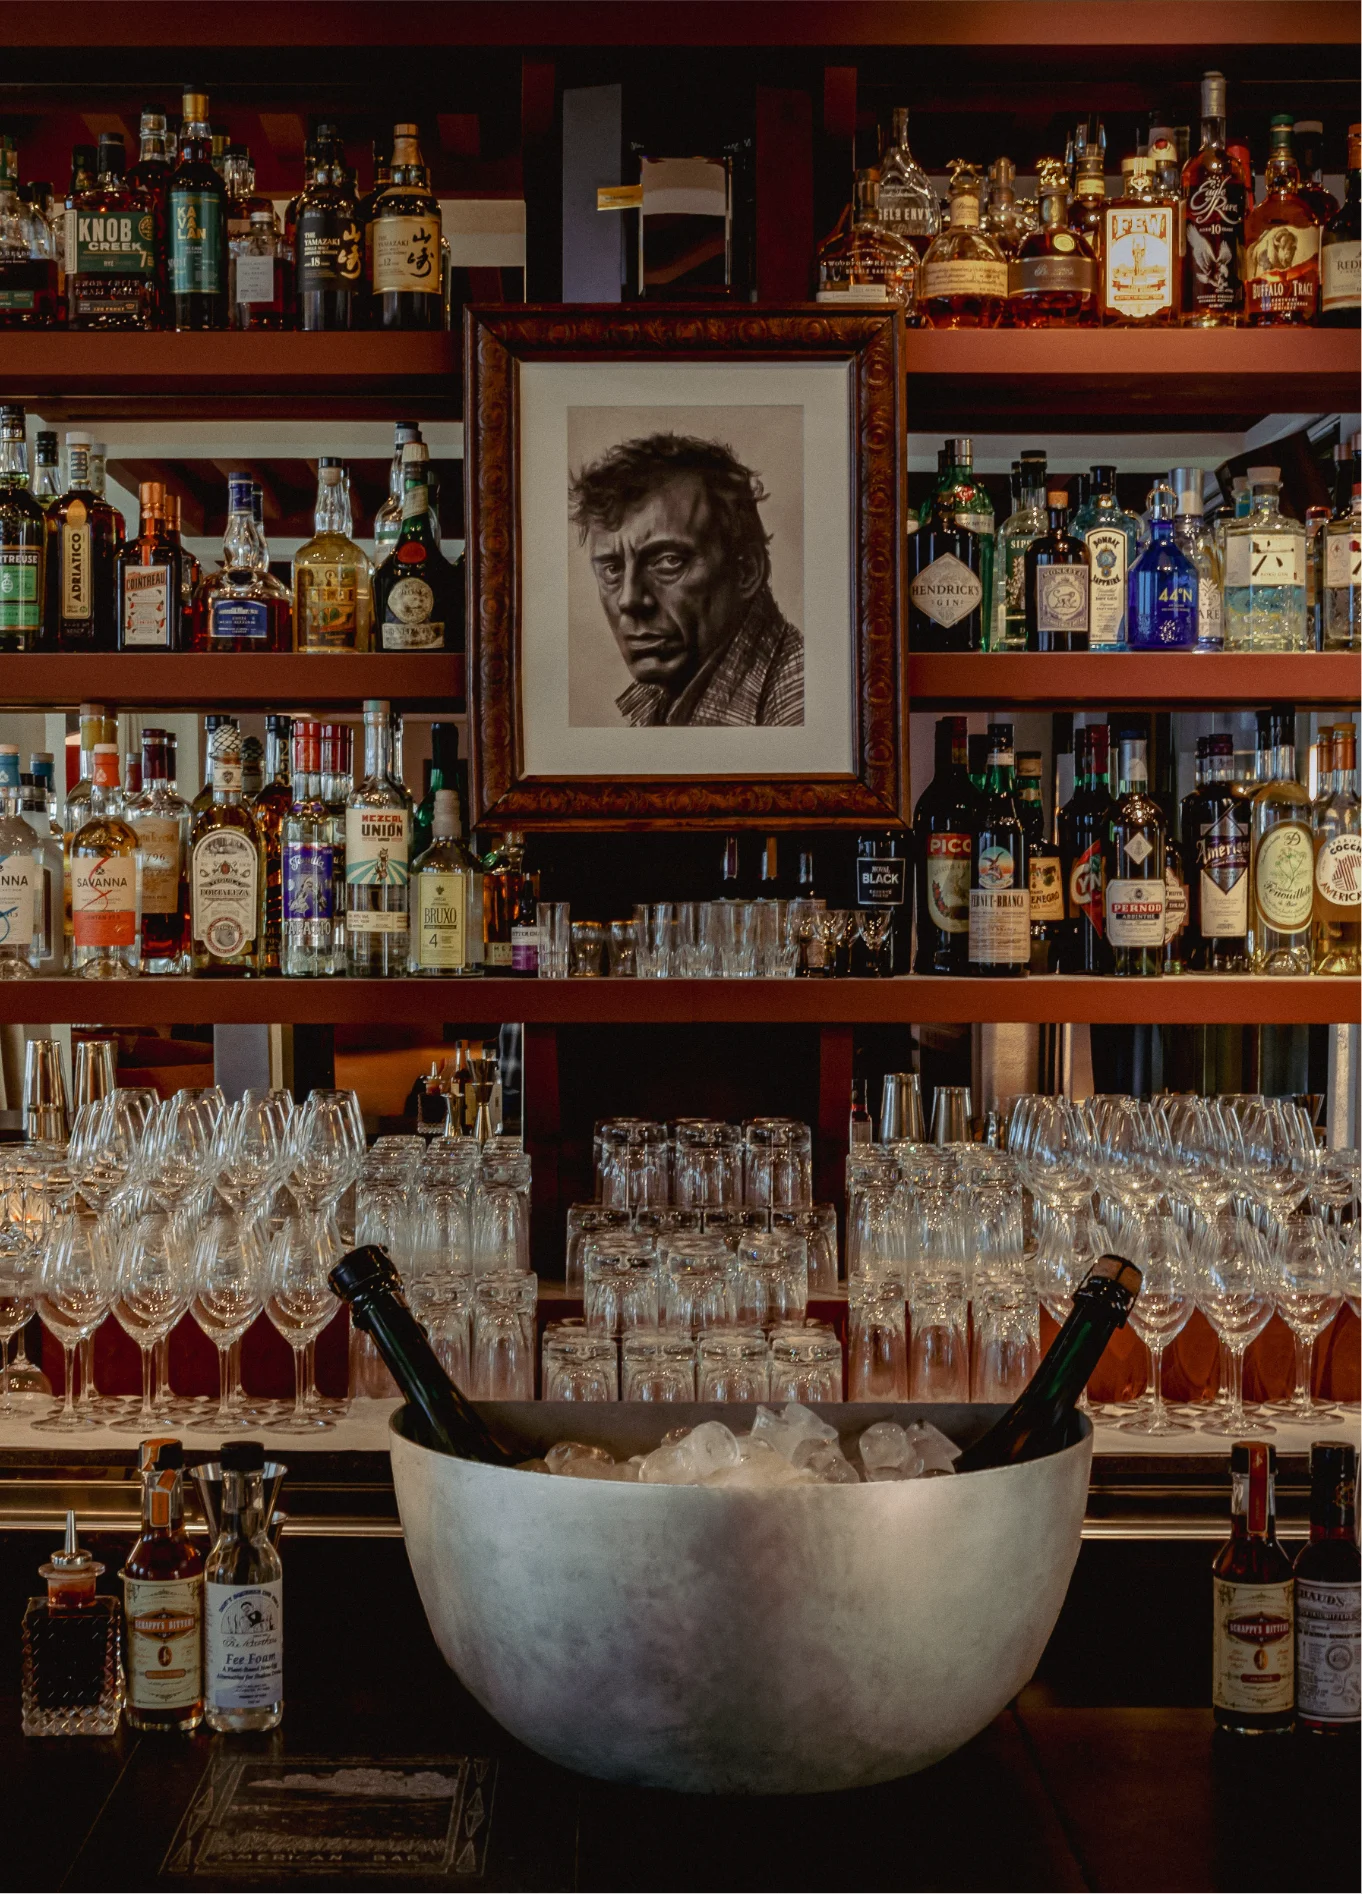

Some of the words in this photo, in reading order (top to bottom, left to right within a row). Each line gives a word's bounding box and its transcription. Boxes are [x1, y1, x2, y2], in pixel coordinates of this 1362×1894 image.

[79, 218, 132, 242] KNOB
[1115, 215, 1162, 237] FEW
[1211, 224, 1221, 235] 10
[177, 228, 207, 239] LAN
[304, 231, 316, 239] THE
[88, 242, 142, 251] CREEK
[304, 238, 340, 246] YAMAZAKI
[140, 250, 147, 268] 7
[310, 257, 320, 267] 18
[383, 258, 391, 266] 12
[1252, 282, 1284, 299] BUFFALO
[1292, 279, 1313, 297] TRACE
[70, 533, 81, 602] ADRIATICO
[126, 571, 167, 590] COINTREAU
[362, 814, 403, 823] MEZCAL
[77, 877, 128, 887] SAVANNA
[862, 872, 899, 884] BLACK
[1114, 903, 1162, 913] PERNOD
[424, 907, 457, 924] BRUXO
[429, 933, 438, 948] 4
[134, 1619, 165, 1630] SCRAPPY'S
[1229, 1623, 1263, 1634] SCRAPPY'S
[1265, 1622, 1289, 1634] BITTERS
[225, 1653, 245, 1665] Fee
[247, 1652, 276, 1665] Foam
[220, 1853, 344, 1862] AMERICAN
[373, 1853, 421, 1862] BAR
